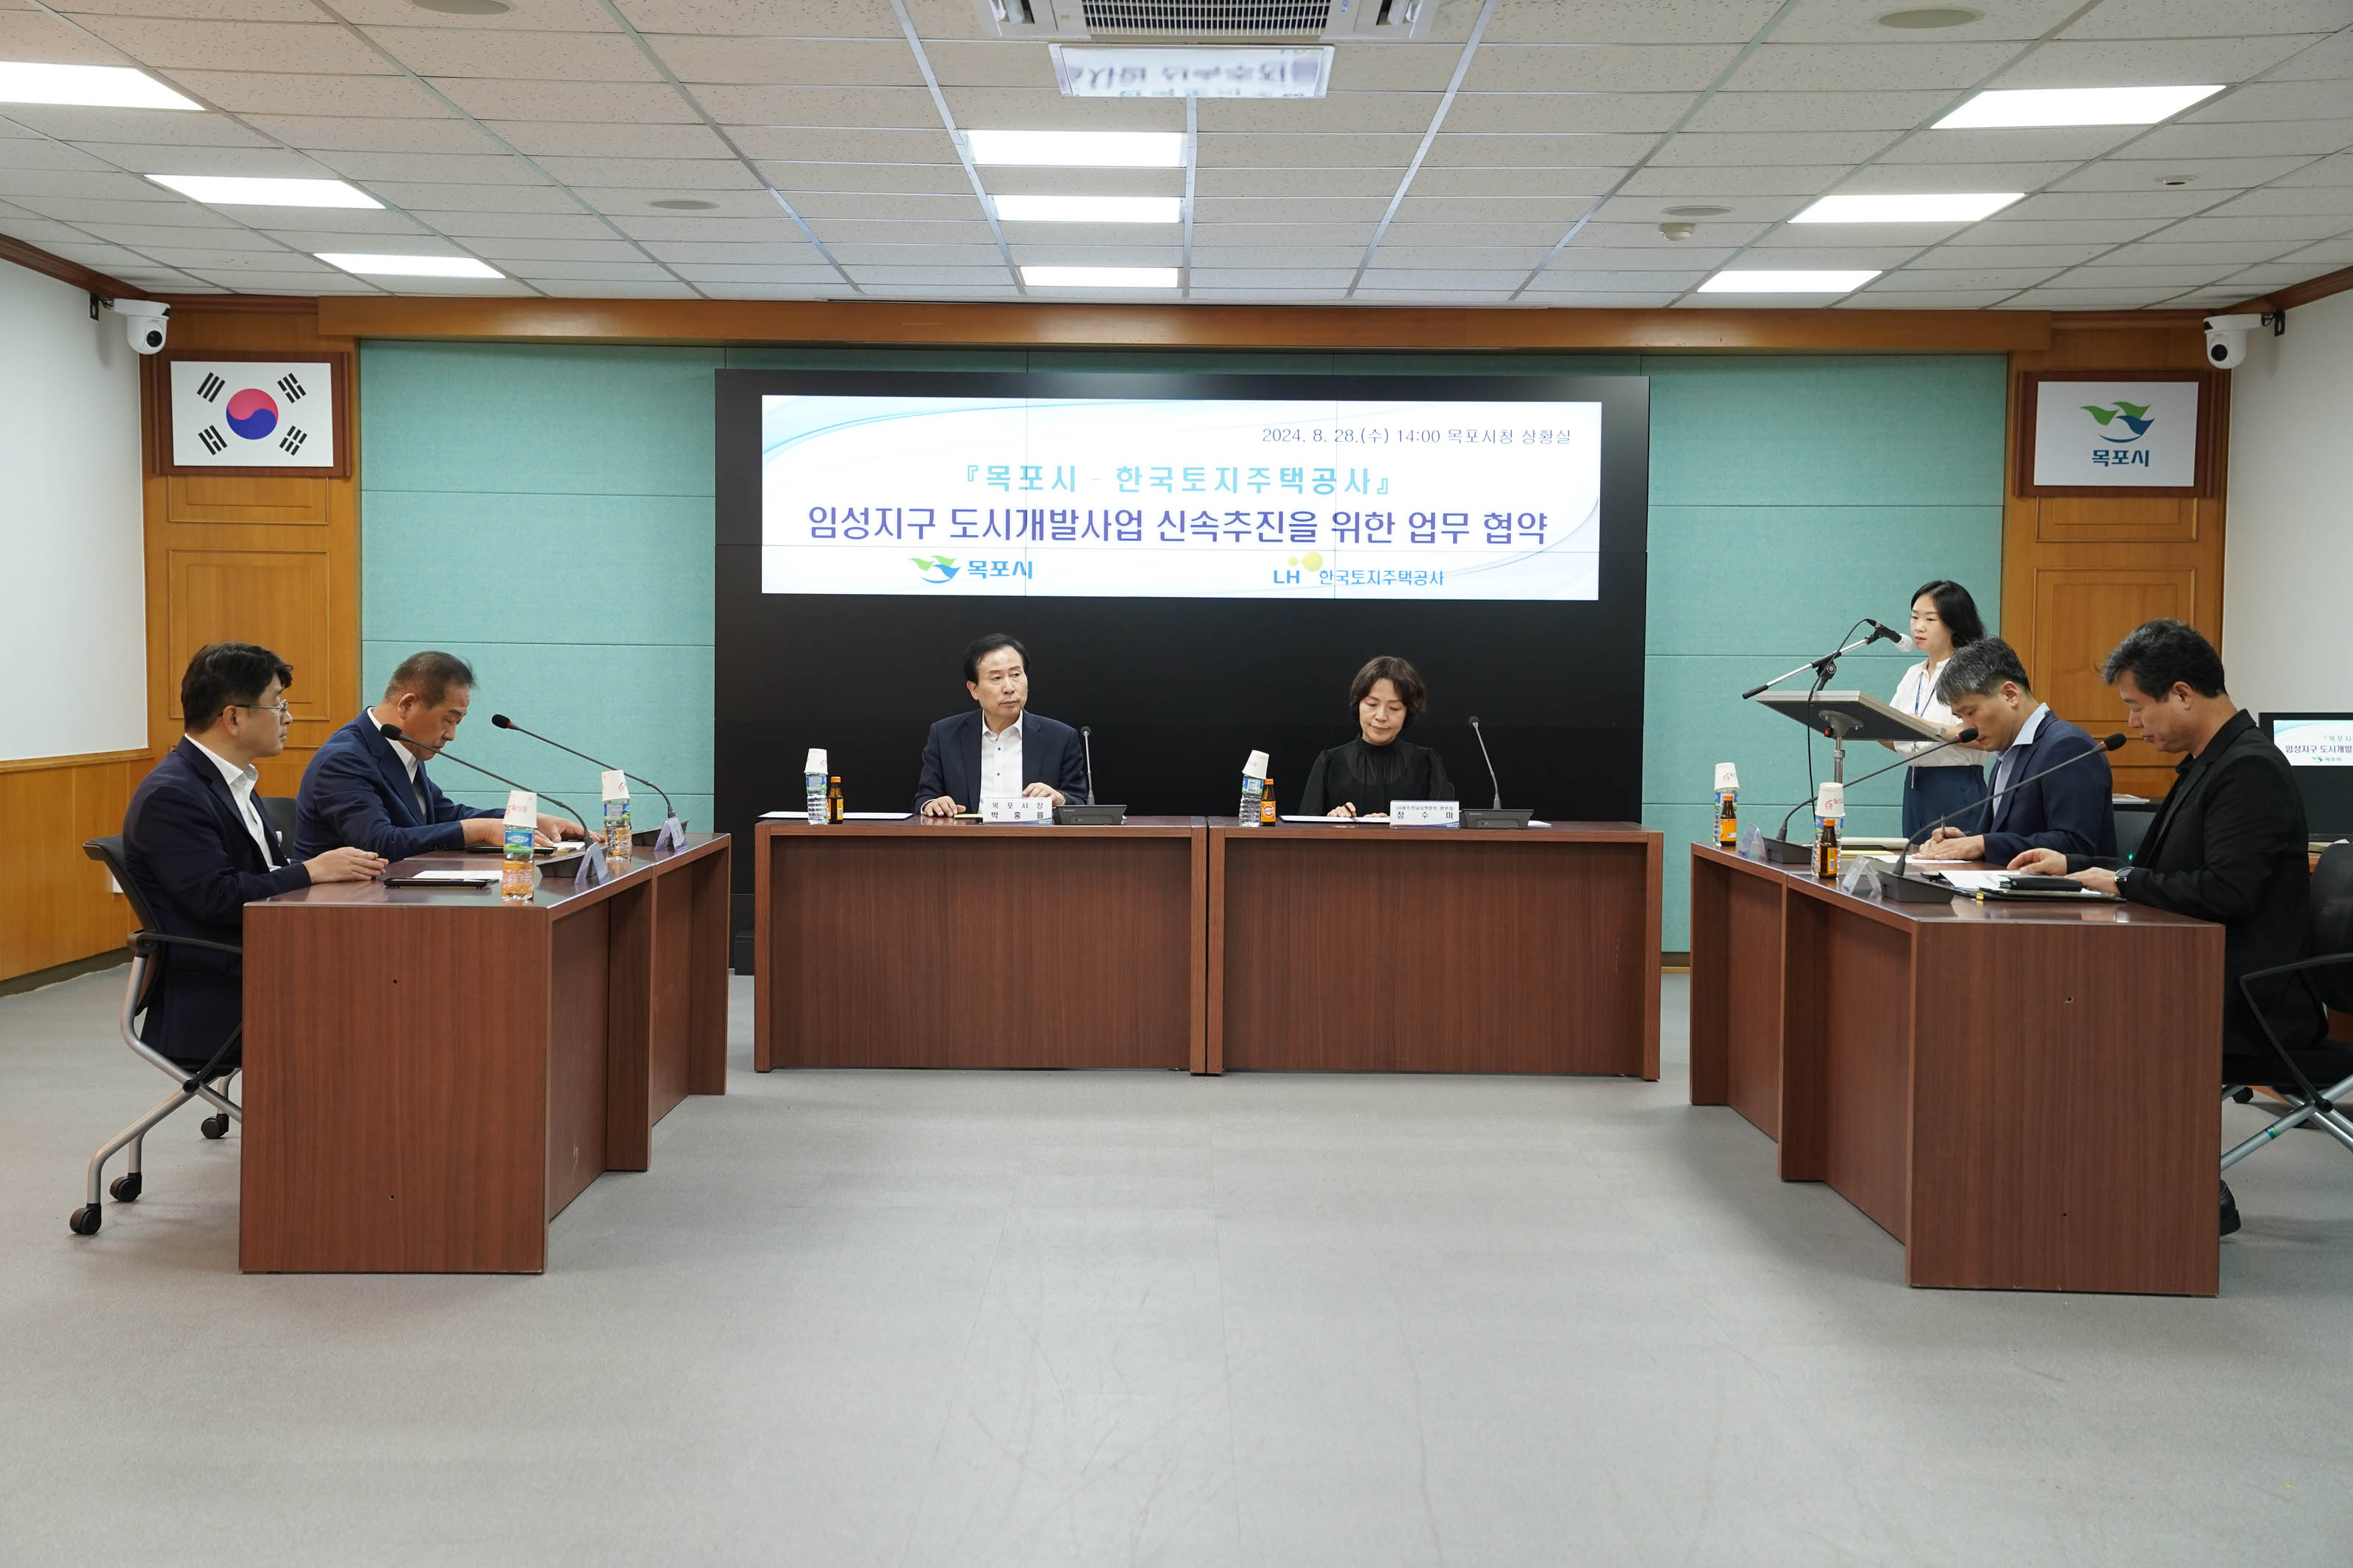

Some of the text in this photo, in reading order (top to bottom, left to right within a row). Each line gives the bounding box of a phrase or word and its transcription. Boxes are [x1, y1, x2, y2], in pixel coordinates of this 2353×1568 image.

[1262, 428, 1572, 445] 2024. 8. 28.(수) 14:00 목포시청 상황실
[2091, 449, 2149, 468] 목포시
[1116, 465, 1389, 495] 한국토지주택공사』
[808, 506, 1548, 545] 임성지구 도시개발사업 신속추진을 위한 업무 협약
[967, 559, 1033, 580] 목포시
[1274, 569, 1300, 584] LH
[1318, 569, 1444, 587] 한국토지주택공사
[2285, 745, 2317, 753] 임성지구
